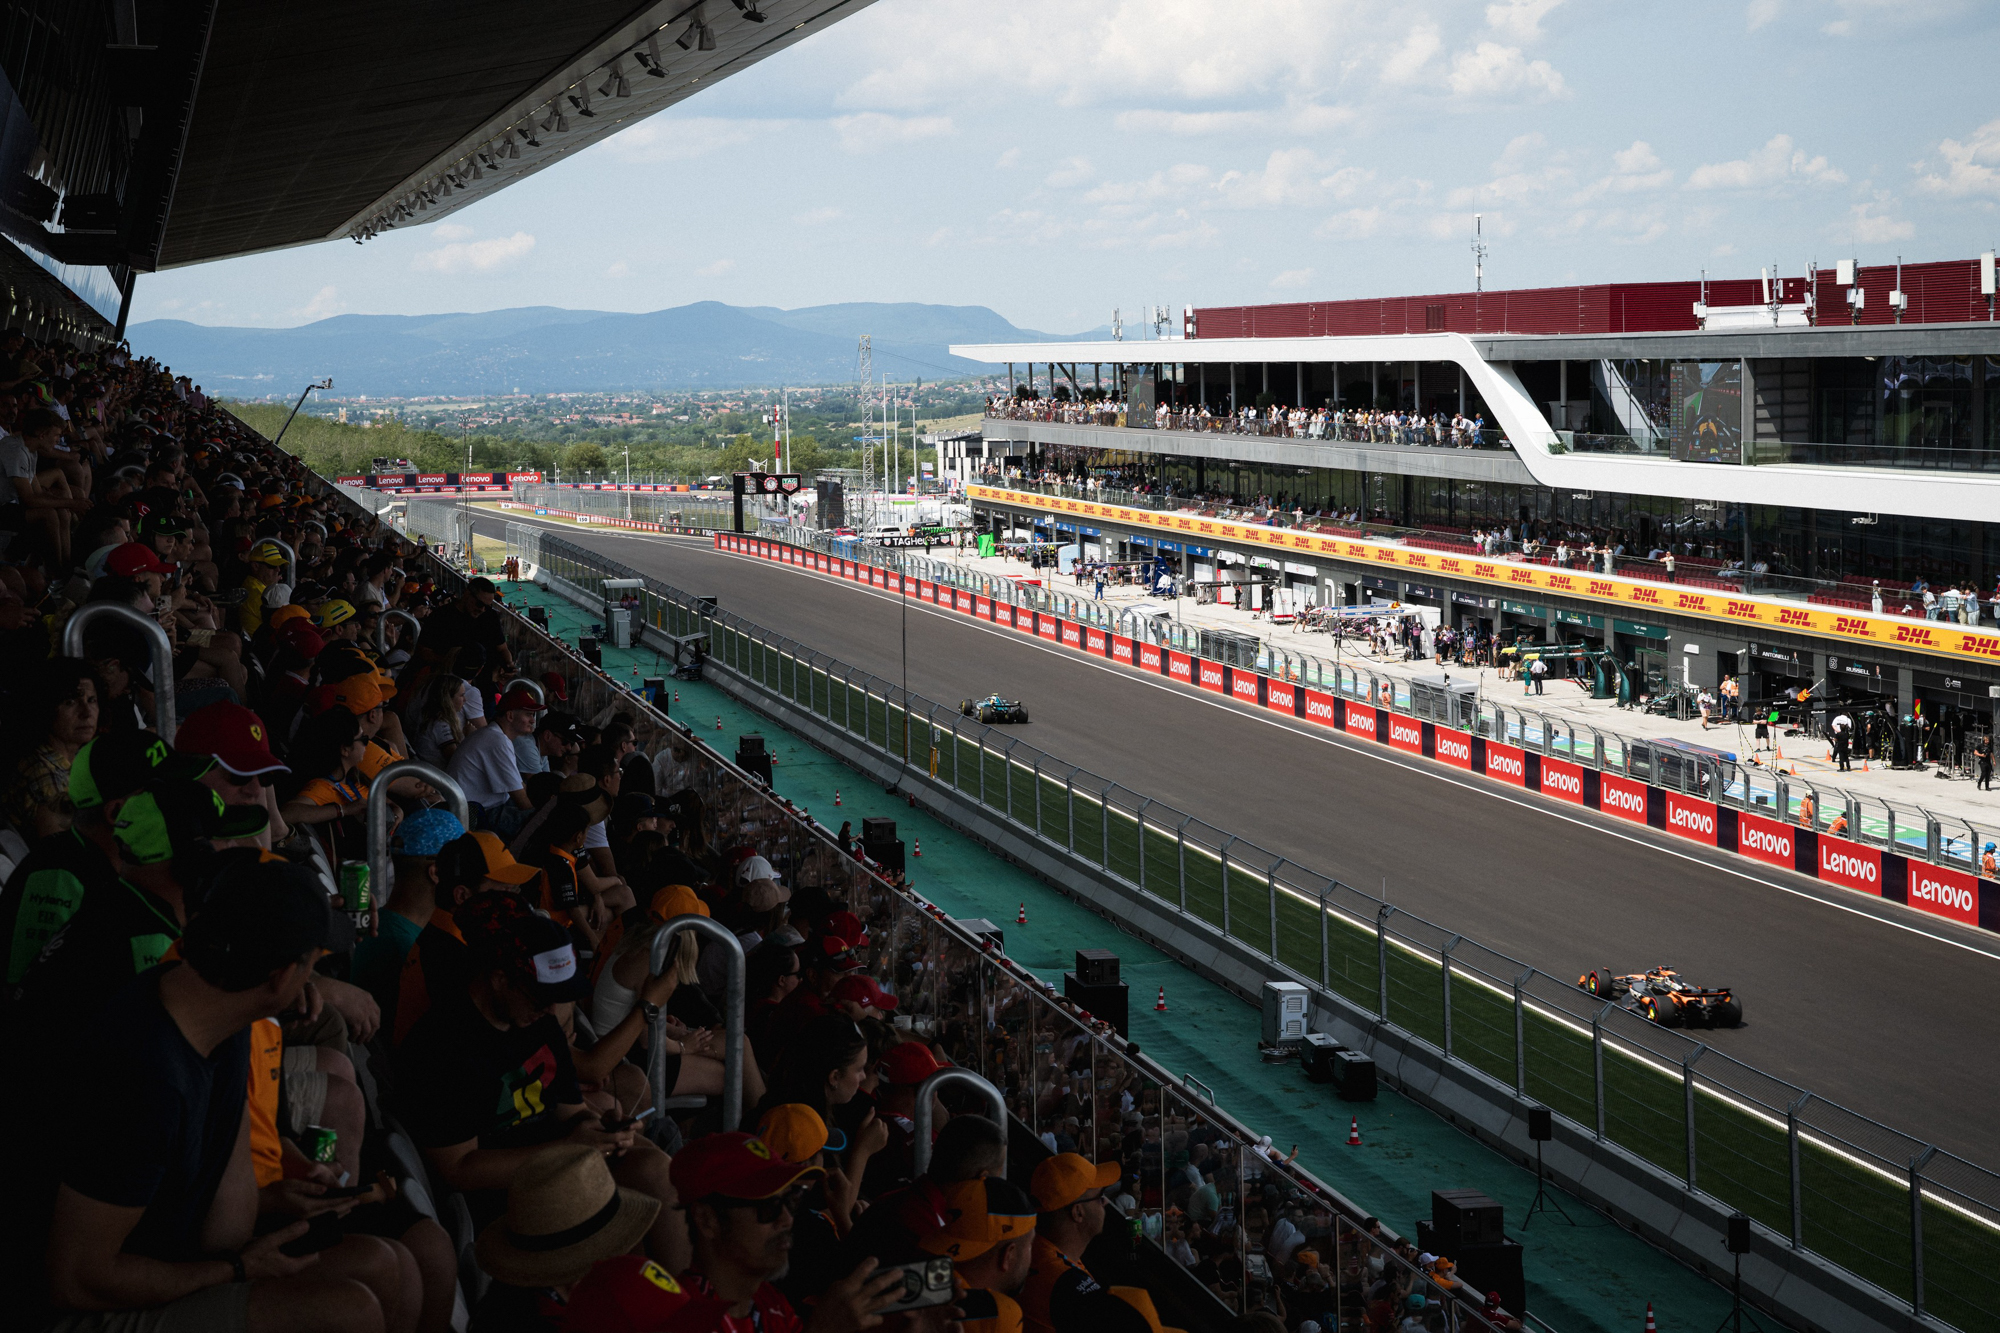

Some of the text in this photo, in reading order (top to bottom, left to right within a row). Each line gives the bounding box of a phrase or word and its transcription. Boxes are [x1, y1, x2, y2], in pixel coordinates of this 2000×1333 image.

[1222, 526, 1236, 537] DHL
[1246, 530, 1259, 541] DHL
[1270, 533, 1284, 545] DHL
[1295, 537, 1310, 549] DHL
[1321, 541, 1337, 553] DHL
[1349, 545, 1365, 558] DHL
[1378, 550, 1395, 562] DHL
[1408, 554, 1427, 567] DHL
[1441, 559, 1460, 572] DHL
[1475, 564, 1496, 578] DHL
[1511, 570, 1533, 584] DHL
[1549, 575, 1572, 590] DHL
[921, 584, 933, 598] Lenovo
[938, 589, 952, 604] Lenovo
[1590, 581, 1614, 596] DHL
[1633, 588, 1659, 603] DHL
[957, 594, 970, 610] Lenovo
[976, 600, 990, 615] Lenovo
[1679, 594, 1706, 610] DHL
[1728, 601, 1757, 618] DHL
[996, 606, 1011, 622] Lenovo
[1017, 612, 1032, 628] Lenovo
[1780, 609, 1811, 627] DHL
[1040, 618, 1056, 635] Lenovo
[1062, 625, 1080, 642] Lenovo
[1836, 617, 1870, 636] DHL
[1087, 632, 1105, 650] Lenovo
[1896, 626, 1933, 646] DHL
[1113, 640, 1132, 658] Lenovo
[1962, 635, 2000, 656] DHL
[1140, 648, 1160, 667] Lenovo
[1762, 651, 1790, 660] ANTONELLI
[1170, 657, 1190, 676] Lenovo
[1846, 666, 1870, 675] RUSSELL
[1200, 666, 1222, 686] Lenovo
[1234, 675, 1256, 696] Lenovo
[1269, 686, 1293, 708] Lenovo
[1306, 696, 1332, 719] Lenovo
[1347, 708, 1374, 732] Lenovo
[1390, 720, 1420, 745] Lenovo
[146, 740, 168, 768] 27
[1438, 734, 1468, 760] Lenovo
[1488, 749, 1522, 776] Lenovo
[1543, 765, 1580, 794] Lenovo
[1604, 782, 1643, 813] Lenovo
[1670, 801, 1713, 834] Lenovo
[1742, 822, 1790, 857] Lenovo
[1823, 845, 1876, 882] Lenovo
[1912, 871, 1972, 911] Lenovo
[30, 893, 72, 909] Hyland
[947, 1244, 960, 1256] 4
